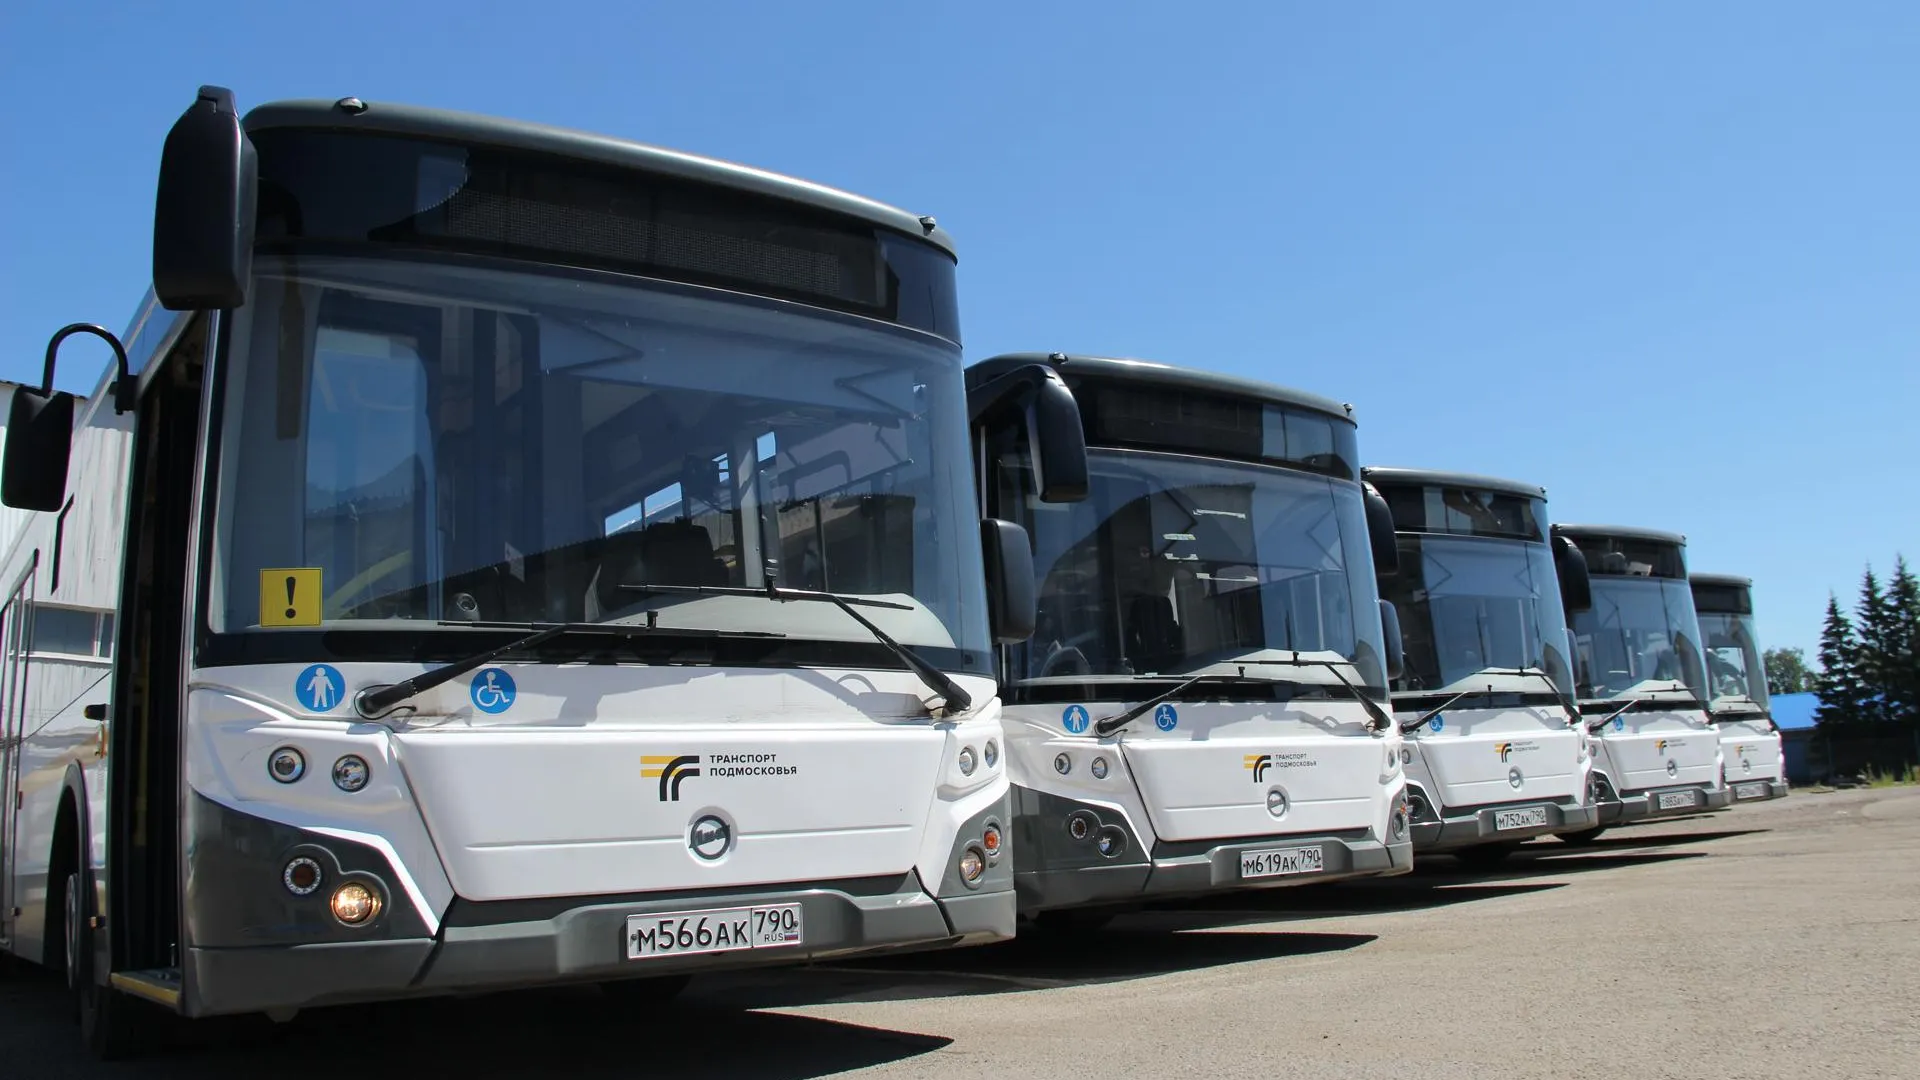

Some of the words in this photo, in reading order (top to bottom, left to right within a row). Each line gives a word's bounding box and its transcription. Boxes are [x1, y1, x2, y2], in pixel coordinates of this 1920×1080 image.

[709, 754, 777, 764] ТРАНСПОРТ
[710, 766, 797, 777] ПОДМОСКОВЬЯ
[1246, 853, 1298, 874] М619АК
[1300, 849, 1320, 864] 790
[637, 917, 748, 954] М566АК
[754, 908, 794, 934] 790
[764, 933, 784, 942] RUS
